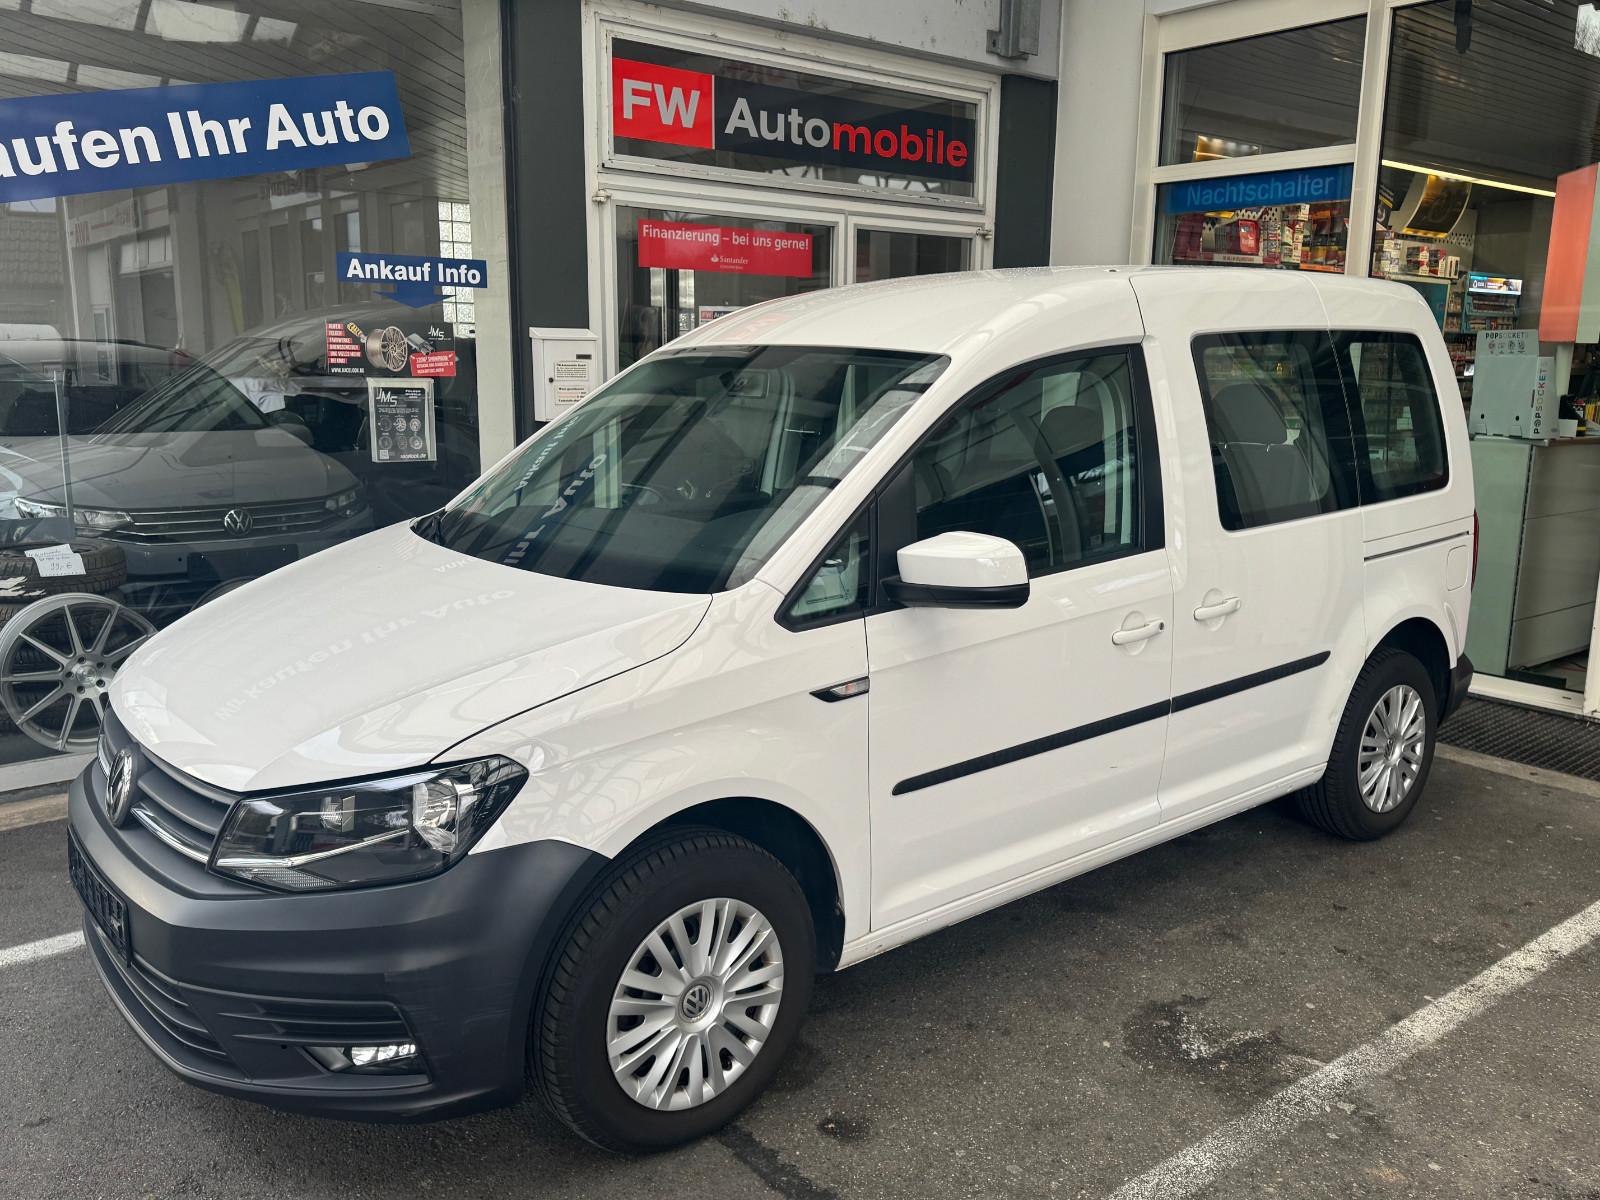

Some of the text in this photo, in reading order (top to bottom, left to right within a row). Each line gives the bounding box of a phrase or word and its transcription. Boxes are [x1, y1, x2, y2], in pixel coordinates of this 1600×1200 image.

[166, 110, 252, 159] Ihr
[266, 100, 390, 151] Auto
[622, 78, 967, 167] FW Automobile
[1187, 175, 1334, 206] Nachtschalter
[642, 224, 720, 245] Finanzierung
[732, 232, 749, 246] bei
[752, 236, 772, 248] uns
[774, 238, 809, 251] gerne!
[346, 258, 481, 285] Ankauf Info
[719, 254, 749, 266] Santander
